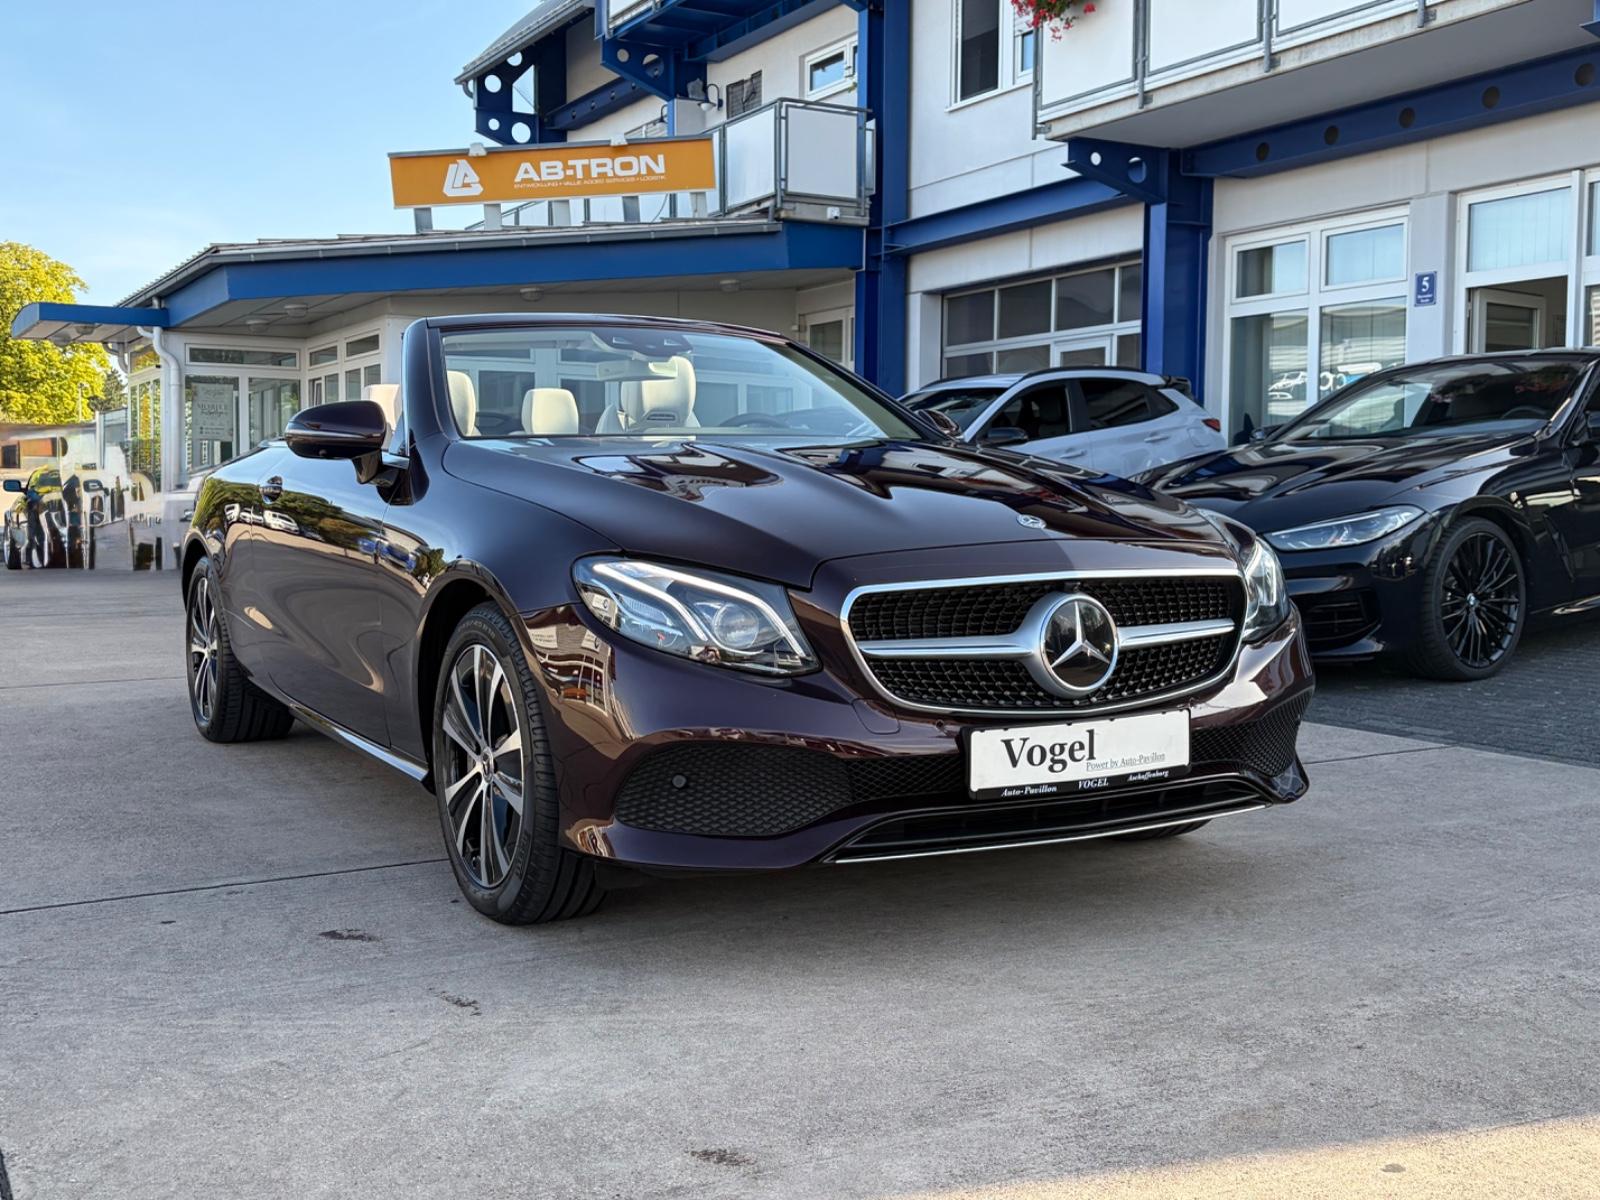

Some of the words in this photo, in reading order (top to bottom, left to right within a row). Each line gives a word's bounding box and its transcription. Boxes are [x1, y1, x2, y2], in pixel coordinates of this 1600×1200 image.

[514, 154, 665, 182] AB-TRON
[1421, 276, 1430, 292] 5
[1001, 729, 1096, 773] Vogel
[1086, 761, 1108, 771] Power
[1110, 758, 1119, 769] by
[1120, 752, 1166, 767] Auto-Pavillon
[1001, 785, 1057, 797] Auto-Pavillon
[1078, 778, 1109, 790] VOGEL
[1127, 770, 1169, 782] Aschaffenburg
